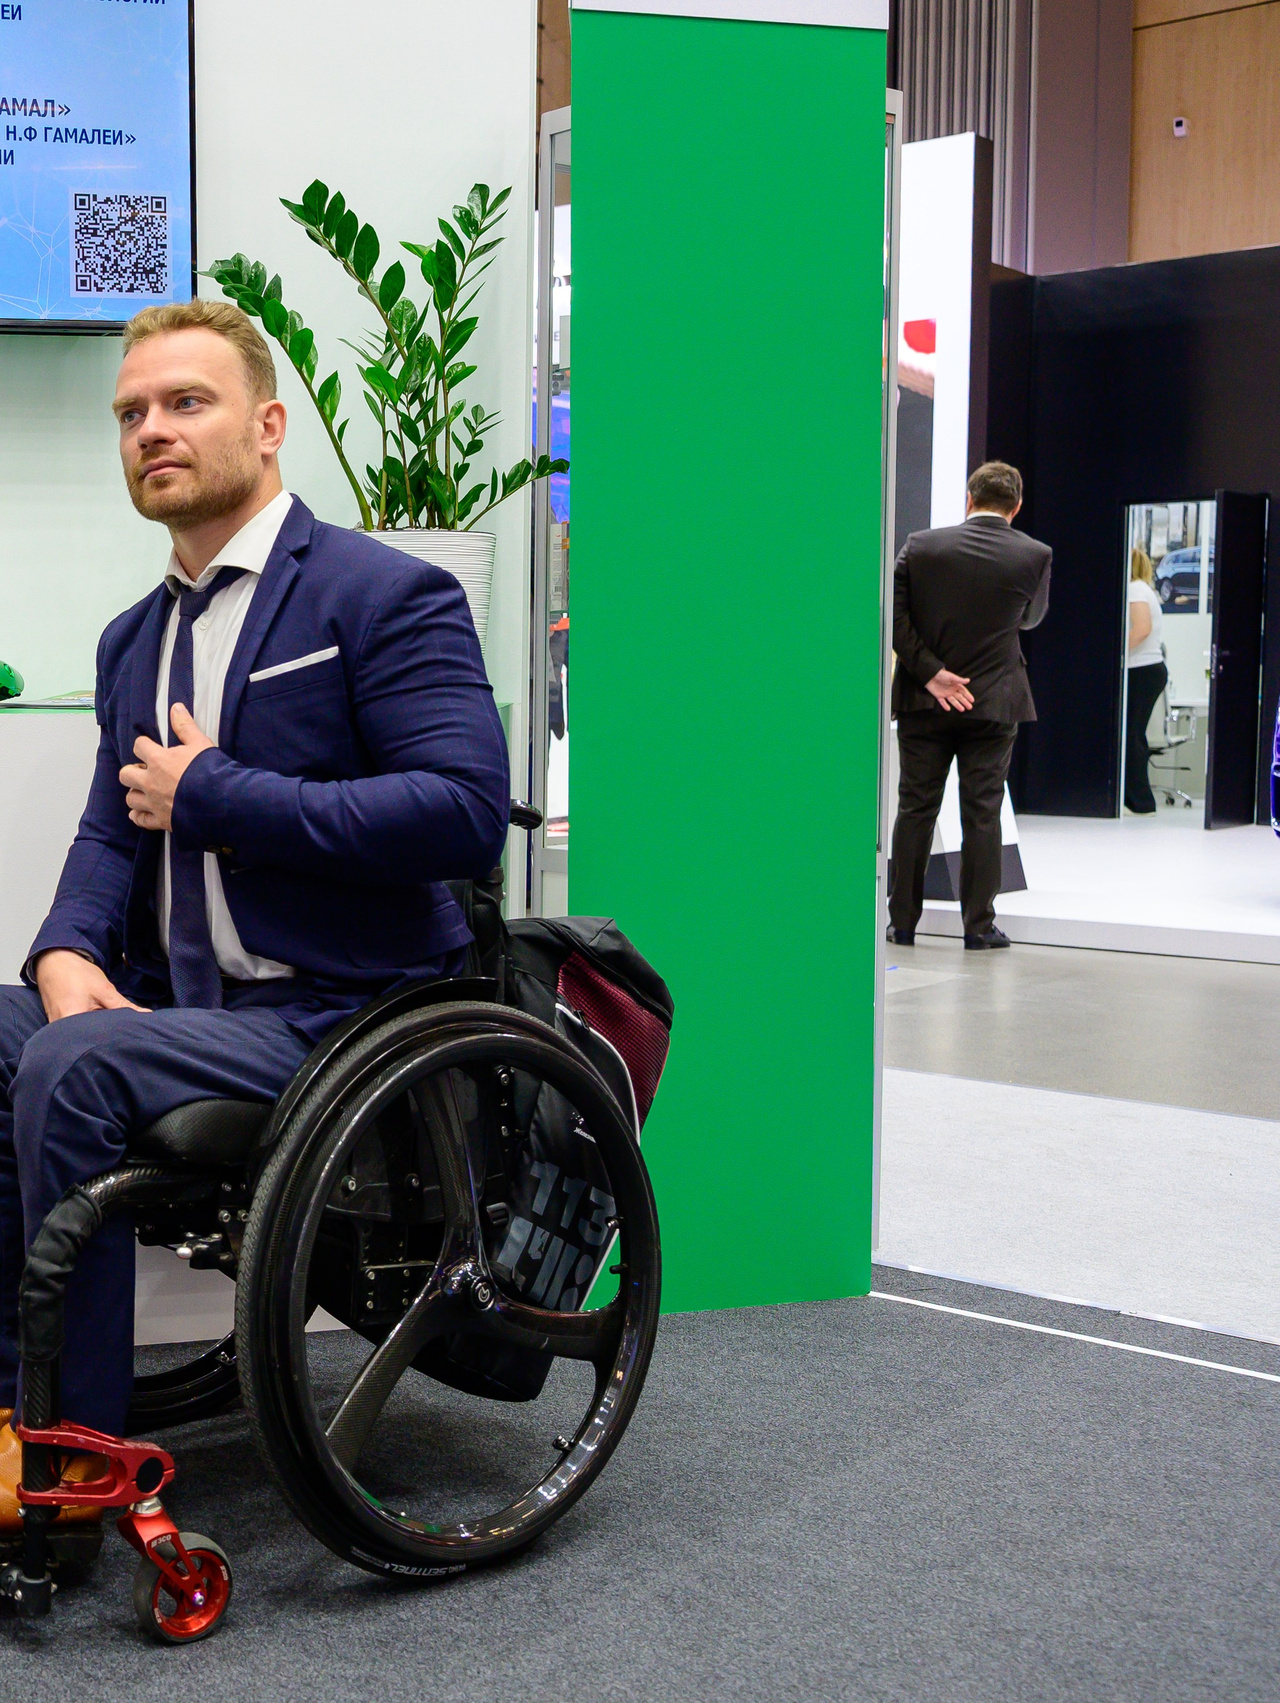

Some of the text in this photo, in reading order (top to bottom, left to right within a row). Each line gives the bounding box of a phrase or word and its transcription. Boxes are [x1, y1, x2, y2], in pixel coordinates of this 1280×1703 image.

[6, 125, 38, 142] Н.Ф
[44, 126, 136, 146] ГАМАЛЕИ»
[391, 1563, 449, 1576] SENTINEL
